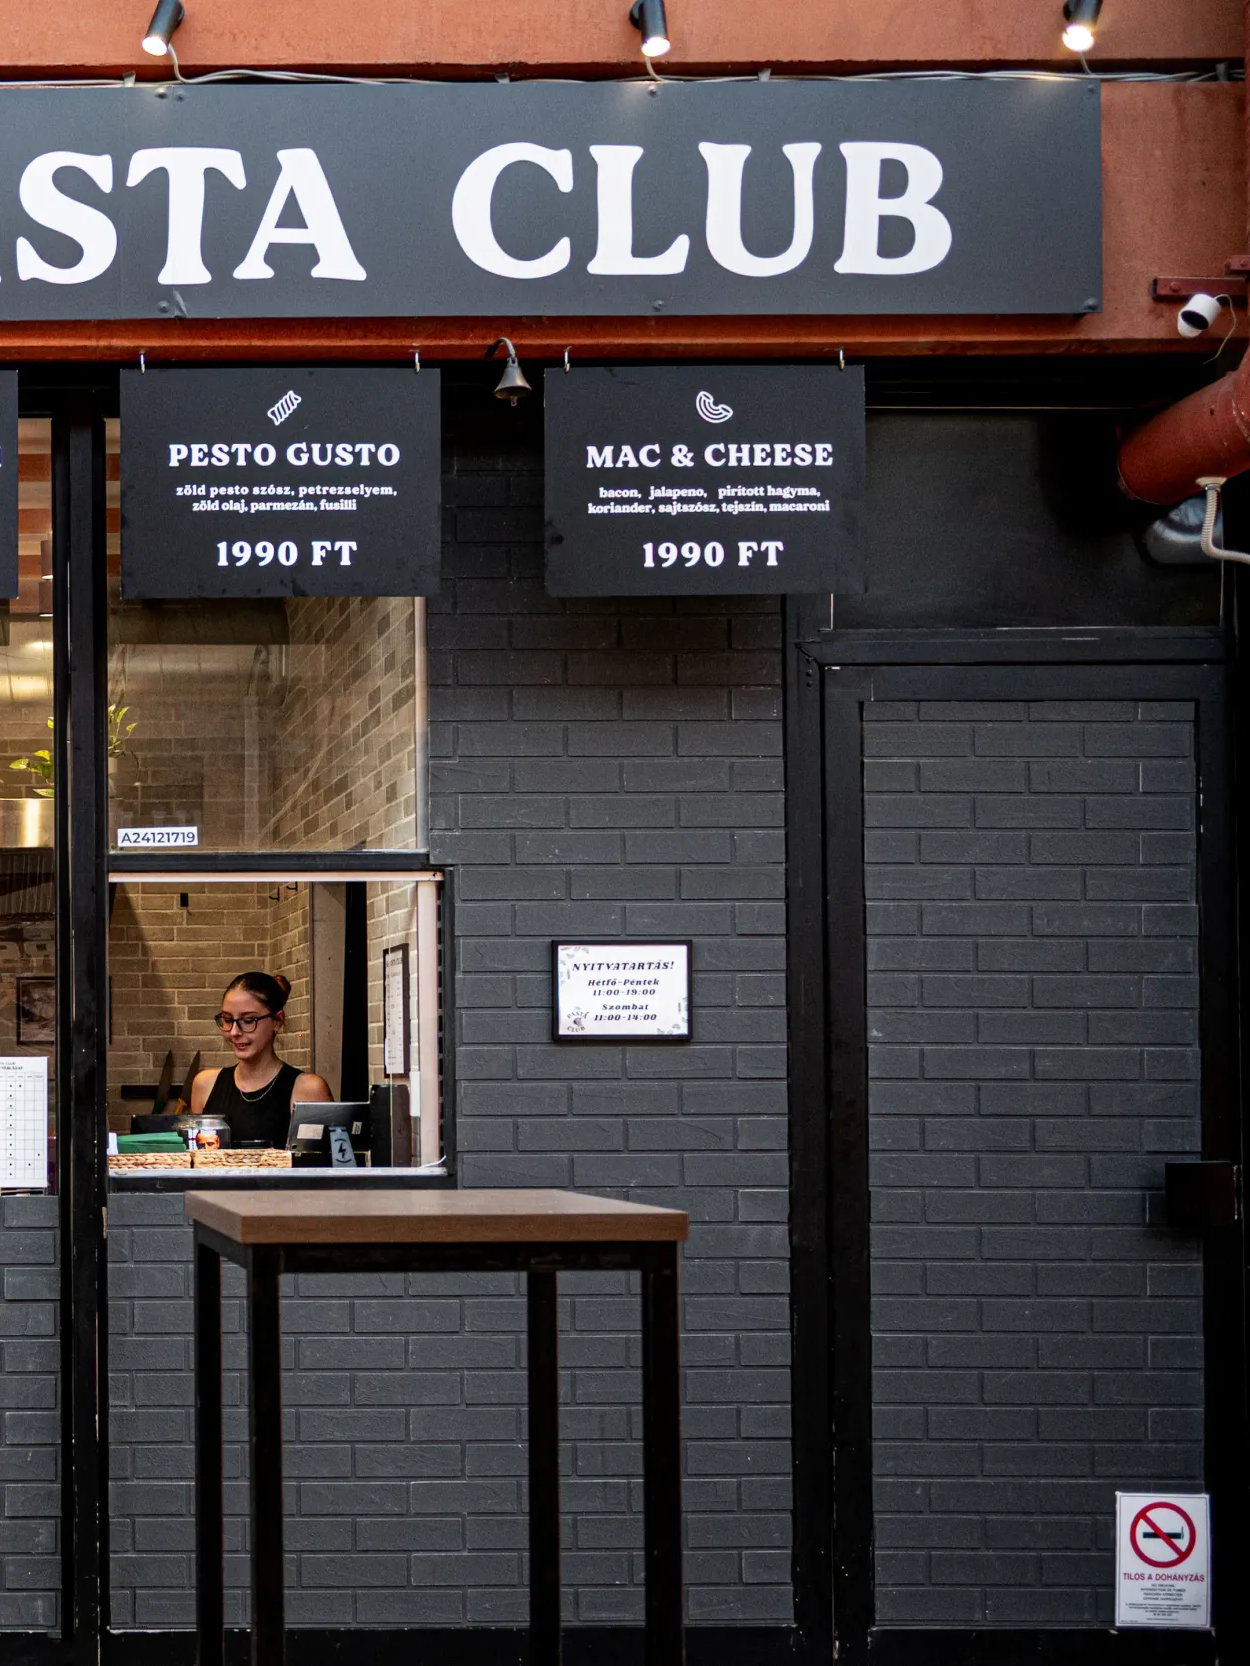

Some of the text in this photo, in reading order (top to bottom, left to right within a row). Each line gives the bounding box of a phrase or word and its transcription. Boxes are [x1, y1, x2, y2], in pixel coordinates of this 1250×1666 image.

[451, 142, 952, 279] CLUB
[168, 442, 400, 467] PESTO GUSTO
[586, 443, 834, 468] MAC & CHEESE
[176, 484, 397, 498] zöld pesto szósz, petrezselyem,
[599, 485, 821, 499] bacon, jalapeno, pirított hagyma,
[192, 499, 357, 513] zöld olaj, parmezán, fusilli
[588, 500, 830, 515] koriander, sajtszósz, tejszín, macaroni
[217, 540, 358, 567] 1990 FT
[643, 541, 784, 567] 1990 FT
[121, 831, 196, 844] A24121719
[572, 960, 675, 972] NYITVATARTÁS!
[602, 1003, 649, 1011] Szombat
[1122, 1572, 1205, 1582] TILOS A DOHÁNYZÁS
